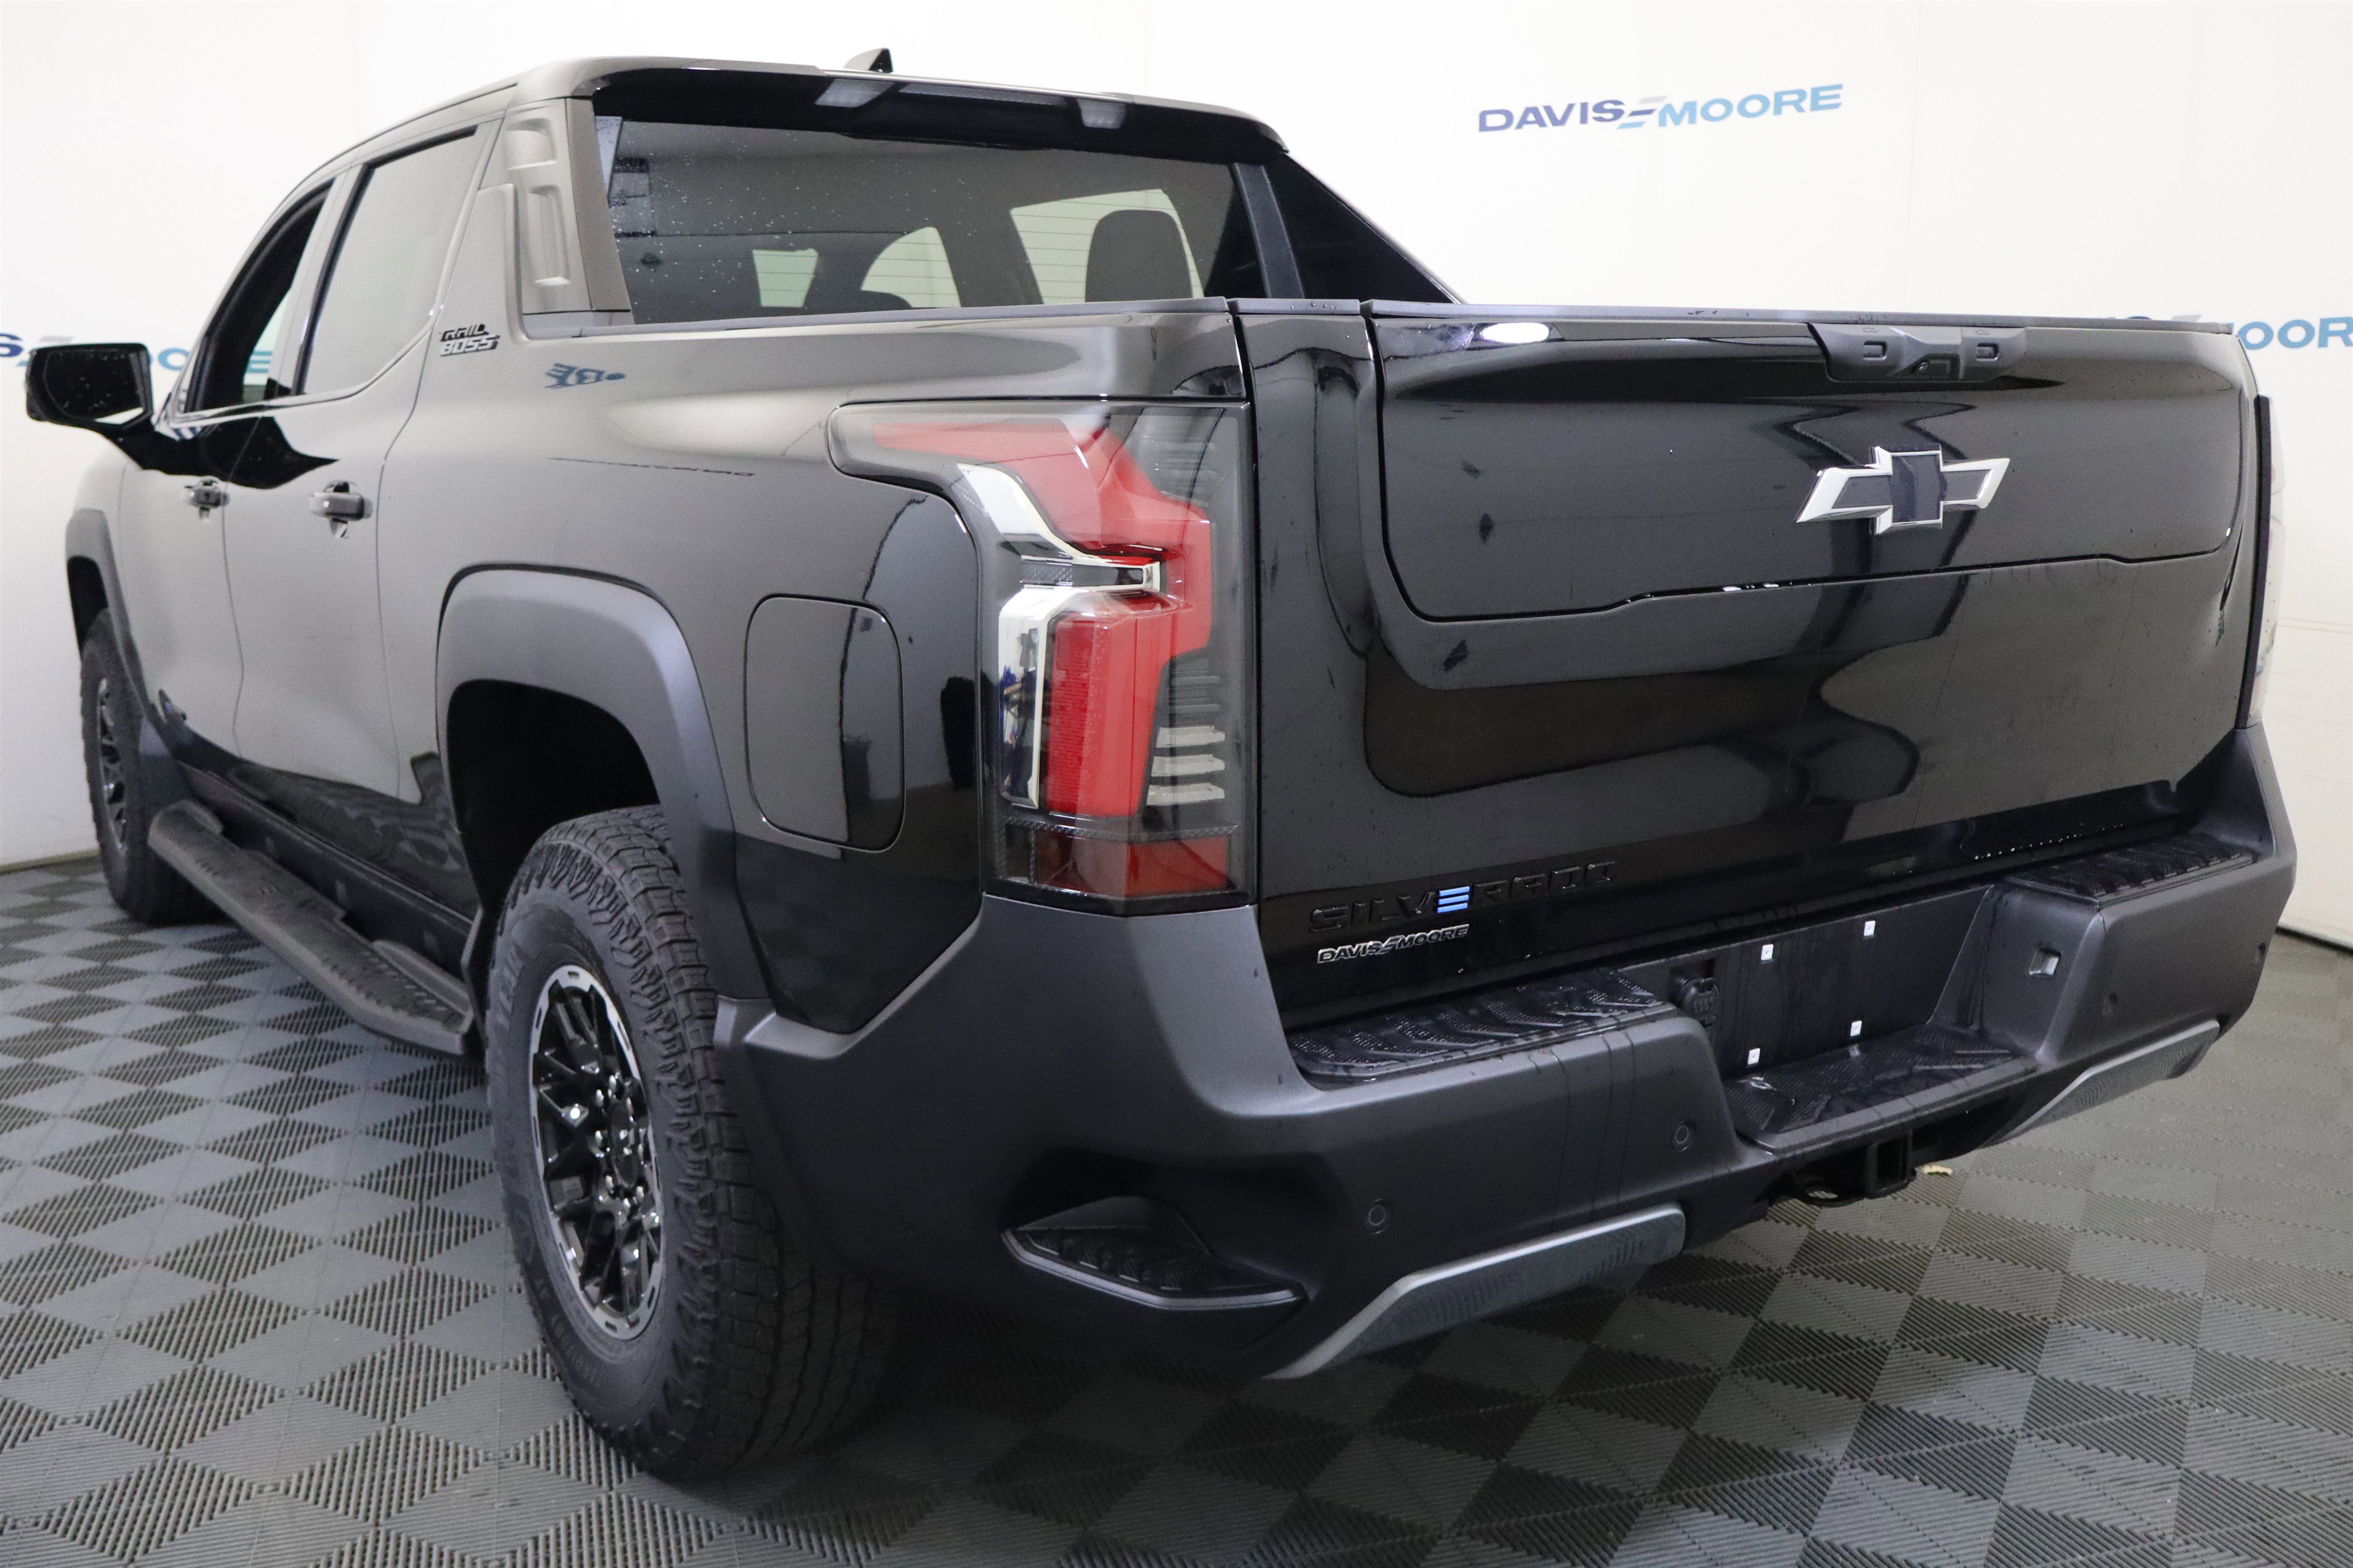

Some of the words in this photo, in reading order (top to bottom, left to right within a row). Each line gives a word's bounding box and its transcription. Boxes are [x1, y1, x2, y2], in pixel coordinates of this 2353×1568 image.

[1478, 99, 1625, 133] DAVIS
[1658, 83, 1843, 128] MOORE
[440, 334, 500, 357] BOSS
[2227, 316, 2353, 350] OOR
[1309, 861, 1615, 933] SILVERADO
[1317, 941, 1383, 964] DAVIS
[1395, 924, 1469, 951] MOORE
